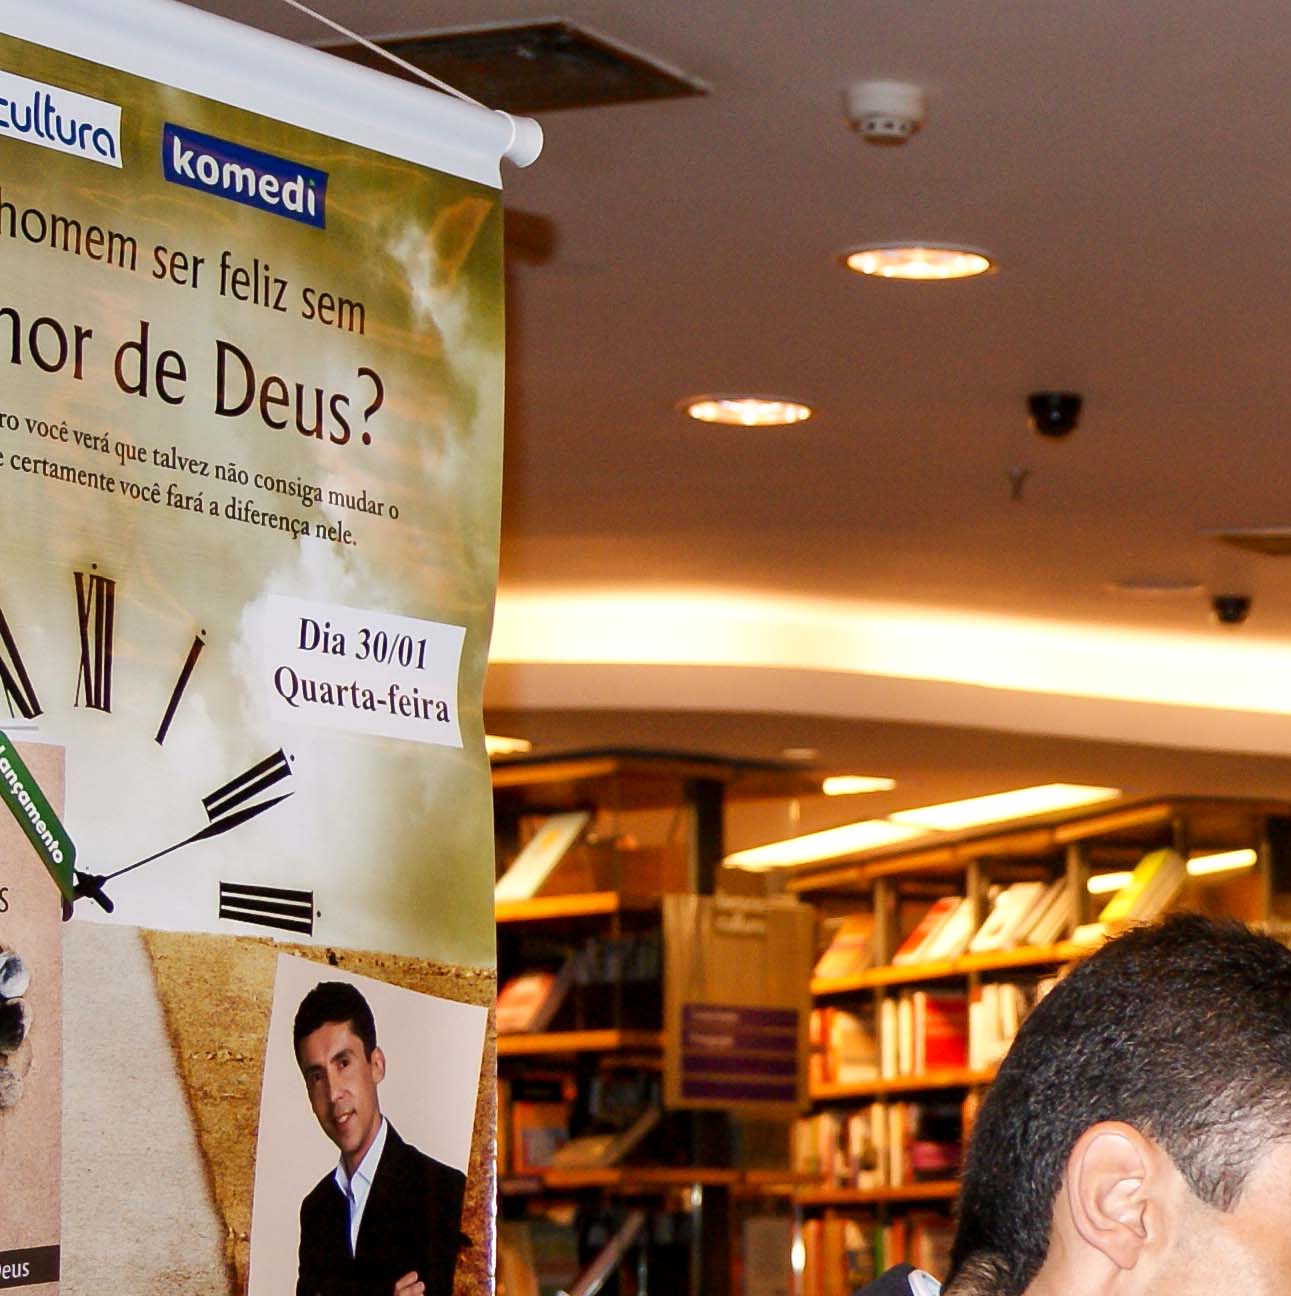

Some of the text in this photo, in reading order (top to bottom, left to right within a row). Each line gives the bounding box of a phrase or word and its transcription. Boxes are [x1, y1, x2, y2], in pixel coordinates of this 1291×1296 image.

[172, 135, 317, 217] komedi
[153, 245, 206, 289] ser
[219, 250, 289, 312] feliz
[302, 287, 366, 335] sem
[114, 320, 188, 406] de
[214, 340, 385, 446] Deus?
[10, 453, 116, 493] certamente
[119, 479, 161, 504] você
[166, 483, 204, 513] fará
[209, 500, 220, 517] a
[224, 496, 310, 540] diferença
[315, 520, 357, 546] nele.
[25, 418, 69, 442] você
[73, 430, 110, 454] verá
[115, 440, 147, 466] que
[153, 446, 210, 477] talvez
[215, 462, 249, 486] não
[254, 472, 323, 508] consiga
[329, 490, 385, 517] mudar
[388, 505, 400, 520] o
[297, 617, 428, 670] Dia 30/01
[273, 665, 451, 723] Quarta-feira
[0, 744, 64, 864] ançamento
[0, 1261, 30, 1280] eus
